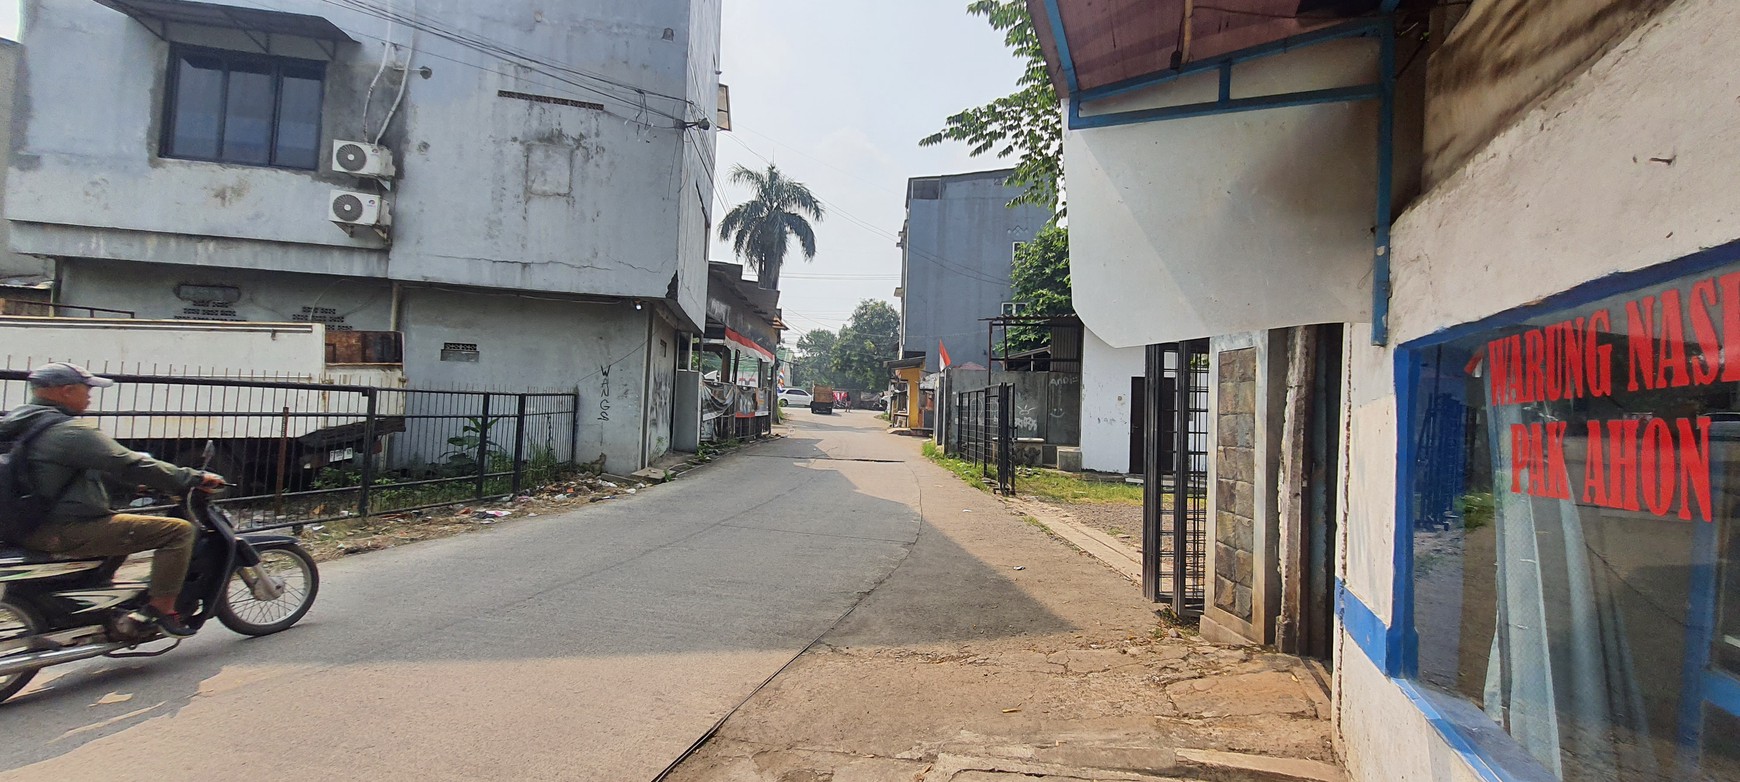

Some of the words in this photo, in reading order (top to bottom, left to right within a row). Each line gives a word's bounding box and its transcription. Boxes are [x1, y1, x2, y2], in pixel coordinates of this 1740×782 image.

[1488, 309, 1612, 406] WARUNG
[1625, 271, 1740, 392] NASI
[1510, 421, 1570, 500] PAK
[1583, 417, 1712, 522] AHON
